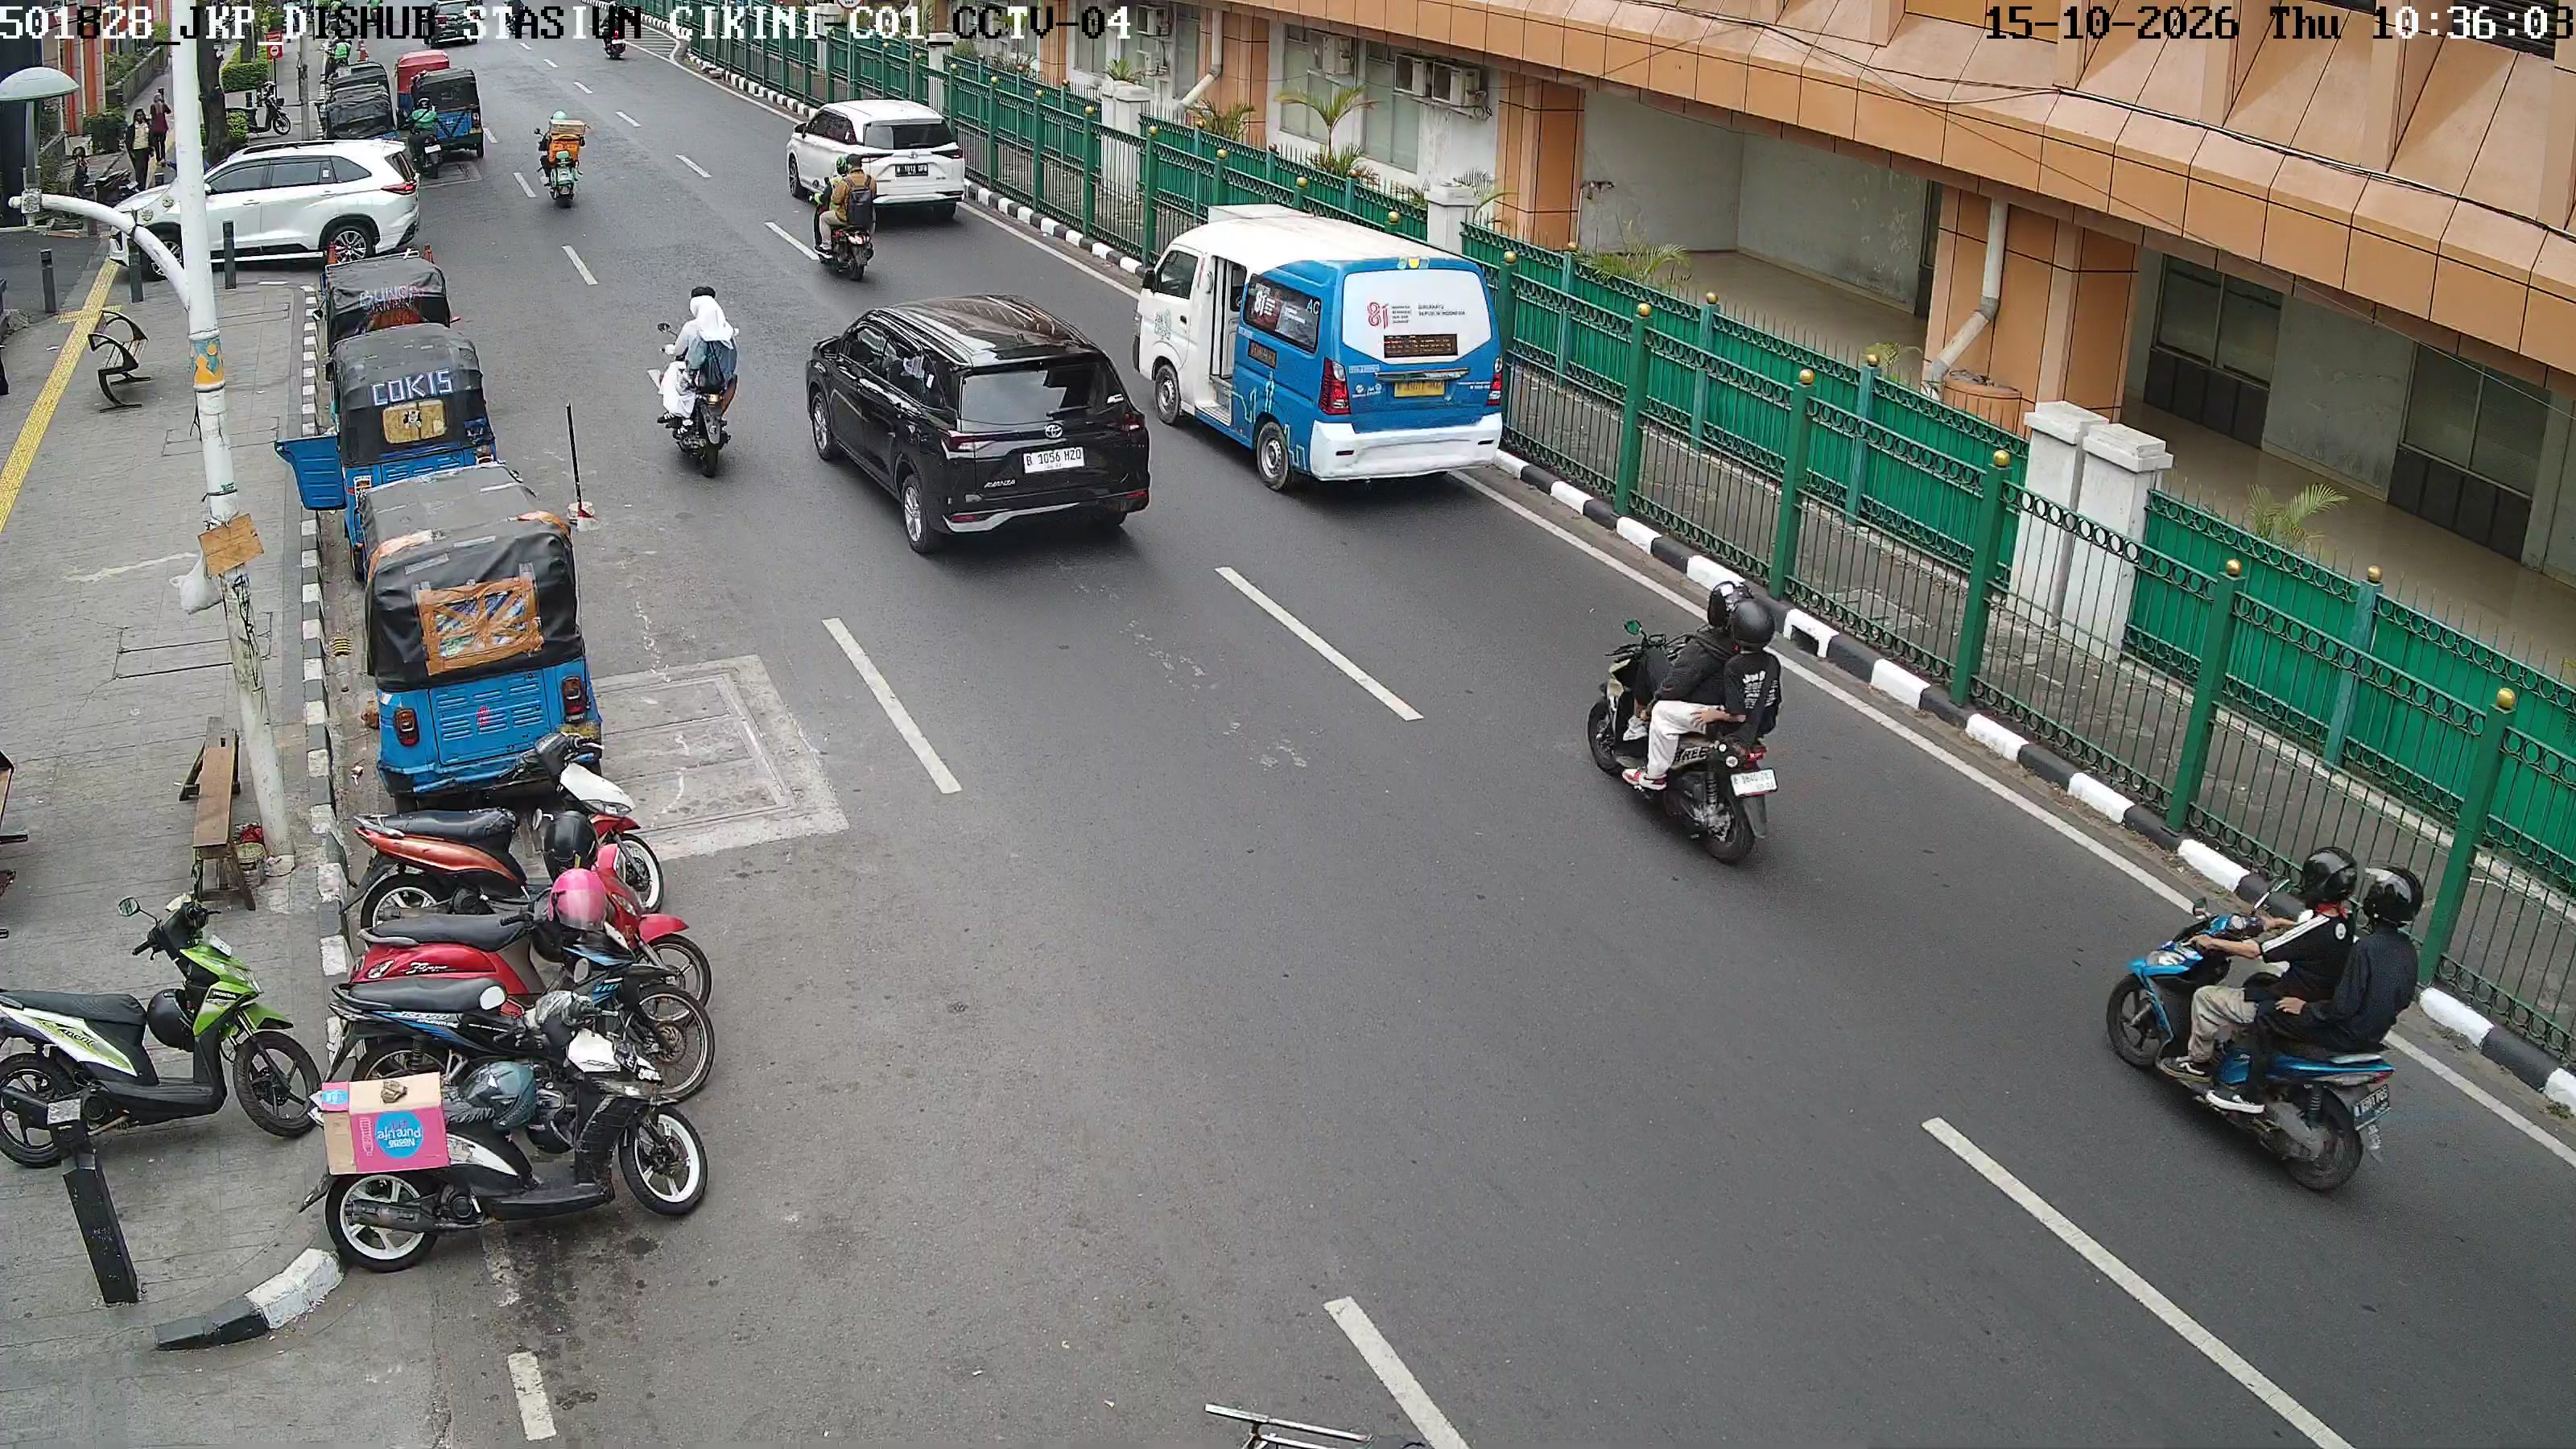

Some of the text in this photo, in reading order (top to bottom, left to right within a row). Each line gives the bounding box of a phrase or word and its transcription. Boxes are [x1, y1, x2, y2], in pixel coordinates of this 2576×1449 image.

[1307, 299, 1320, 316] AC
[371, 368, 452, 406] COKIS
[1038, 452, 1061, 464] 1056
